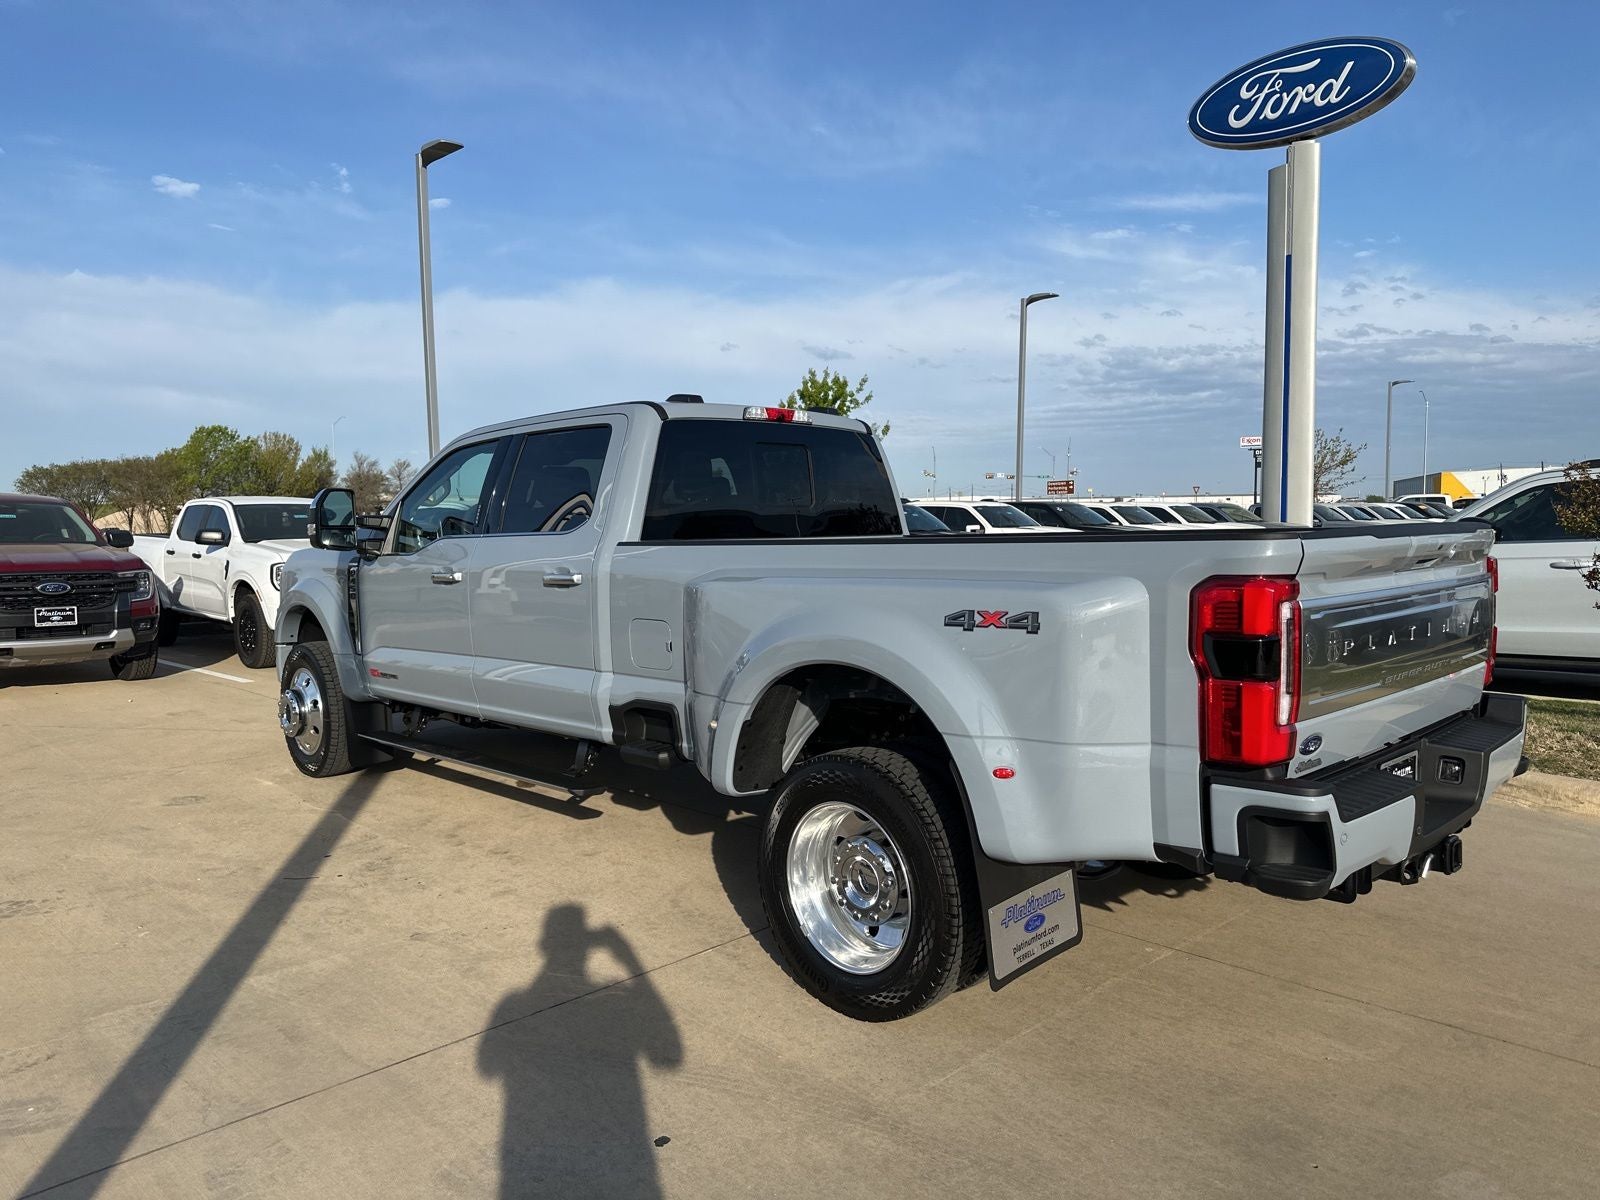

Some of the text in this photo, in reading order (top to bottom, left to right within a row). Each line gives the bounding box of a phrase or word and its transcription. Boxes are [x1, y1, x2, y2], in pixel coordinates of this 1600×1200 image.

[1228, 58, 1354, 129] Ford
[1241, 437, 1261, 445] Exxon
[1000, 888, 1066, 929] Platinum
[1012, 924, 1060, 956] platinumford.com
[1016, 938, 1055, 964] TERRELL TEXAS
